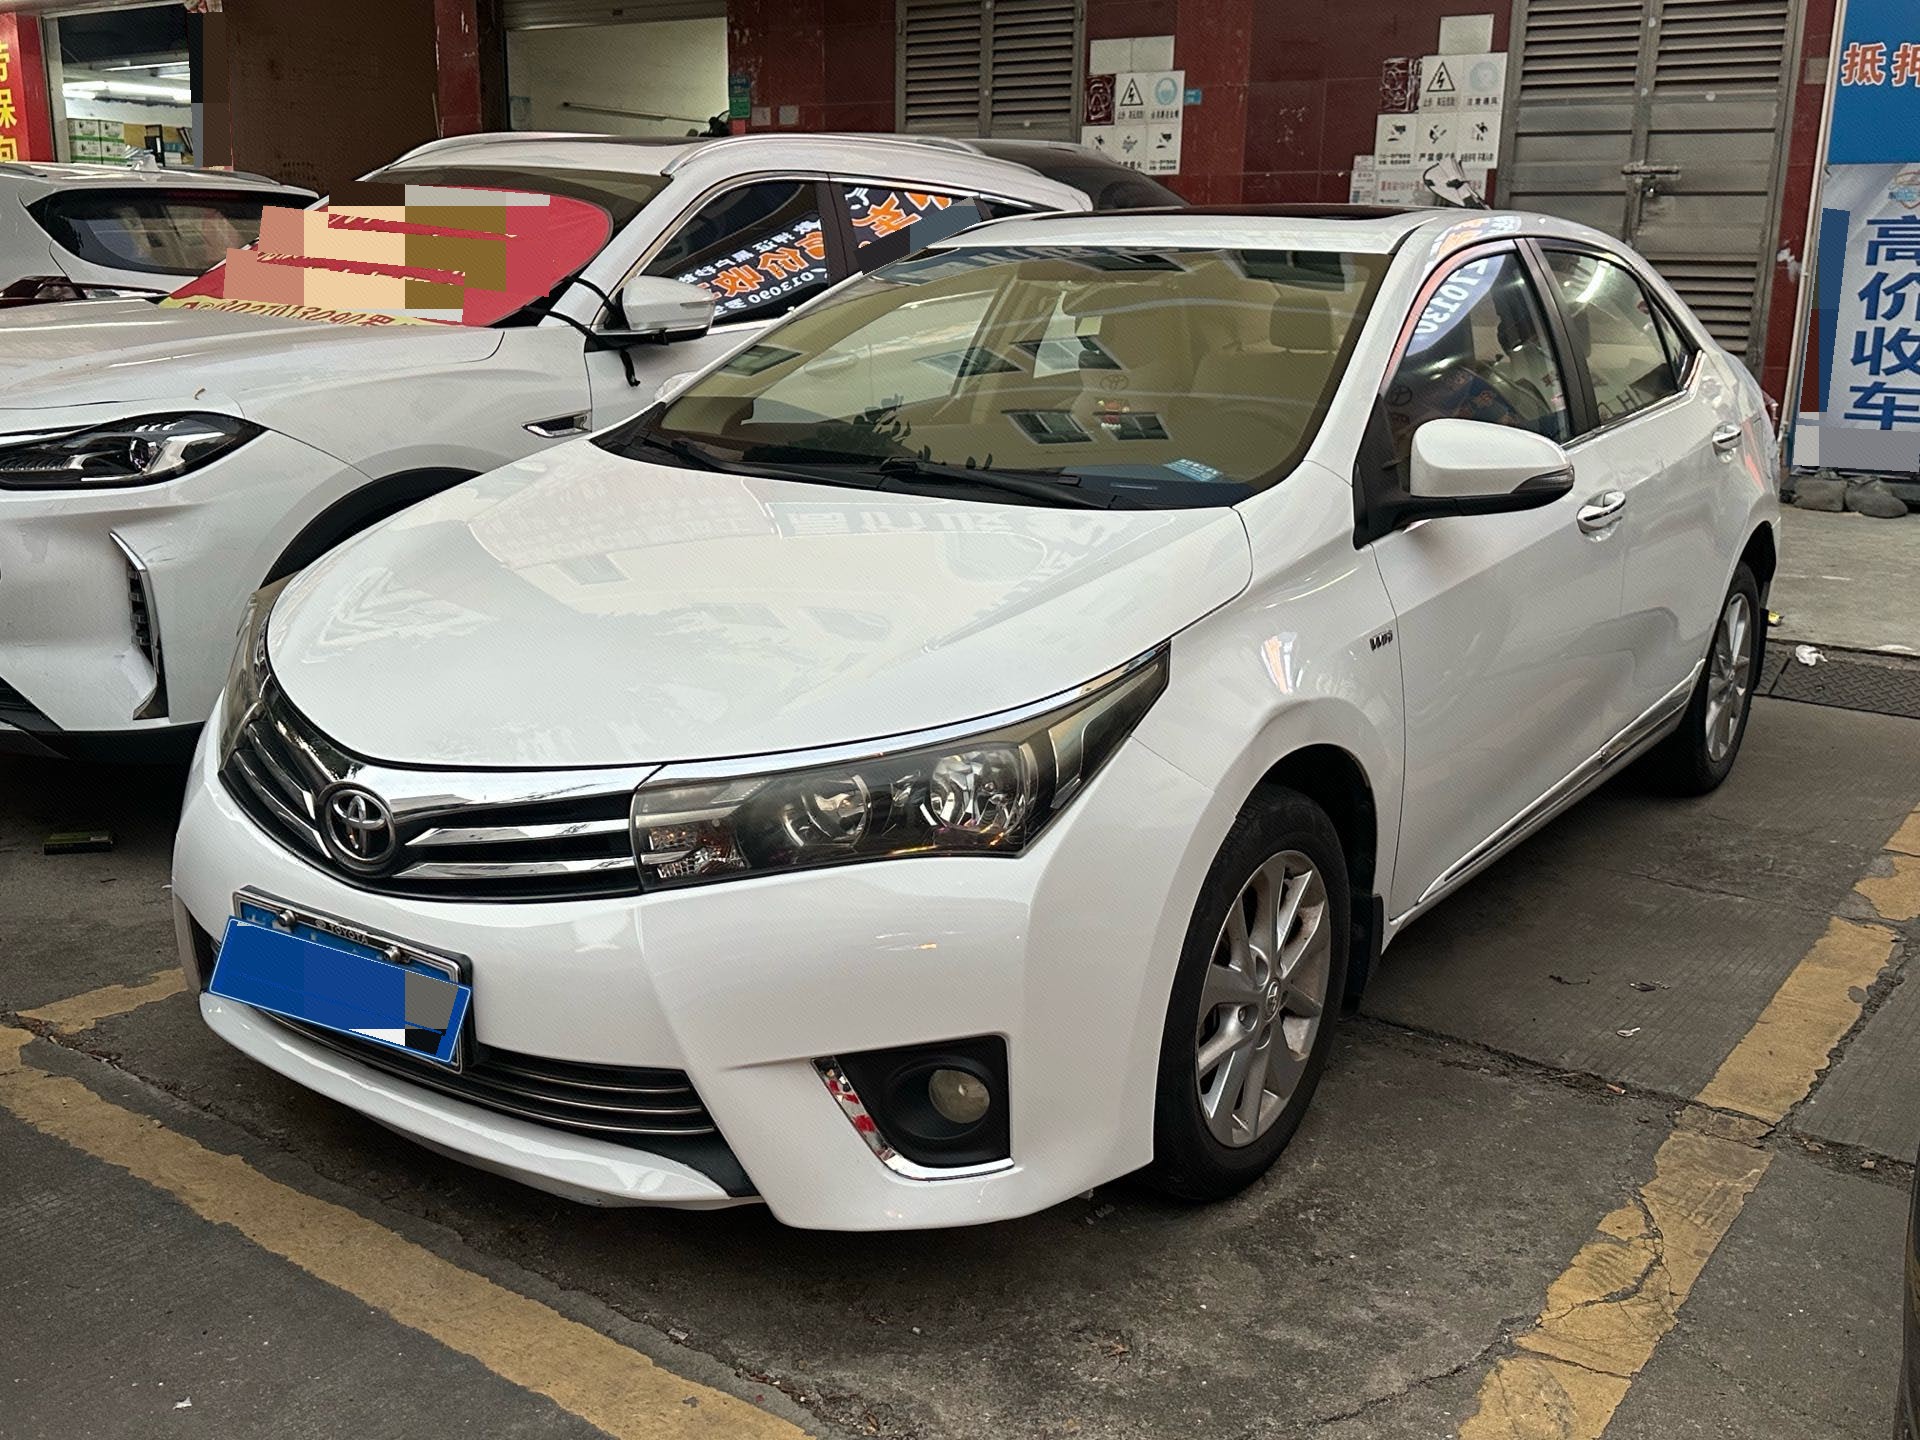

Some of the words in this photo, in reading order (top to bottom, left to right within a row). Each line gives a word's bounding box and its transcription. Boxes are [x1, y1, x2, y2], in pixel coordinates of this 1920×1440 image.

[1841, 42, 1920, 88] 抵押
[1844, 214, 1920, 431] 高价收车
[329, 923, 369, 946] TOYOTA
